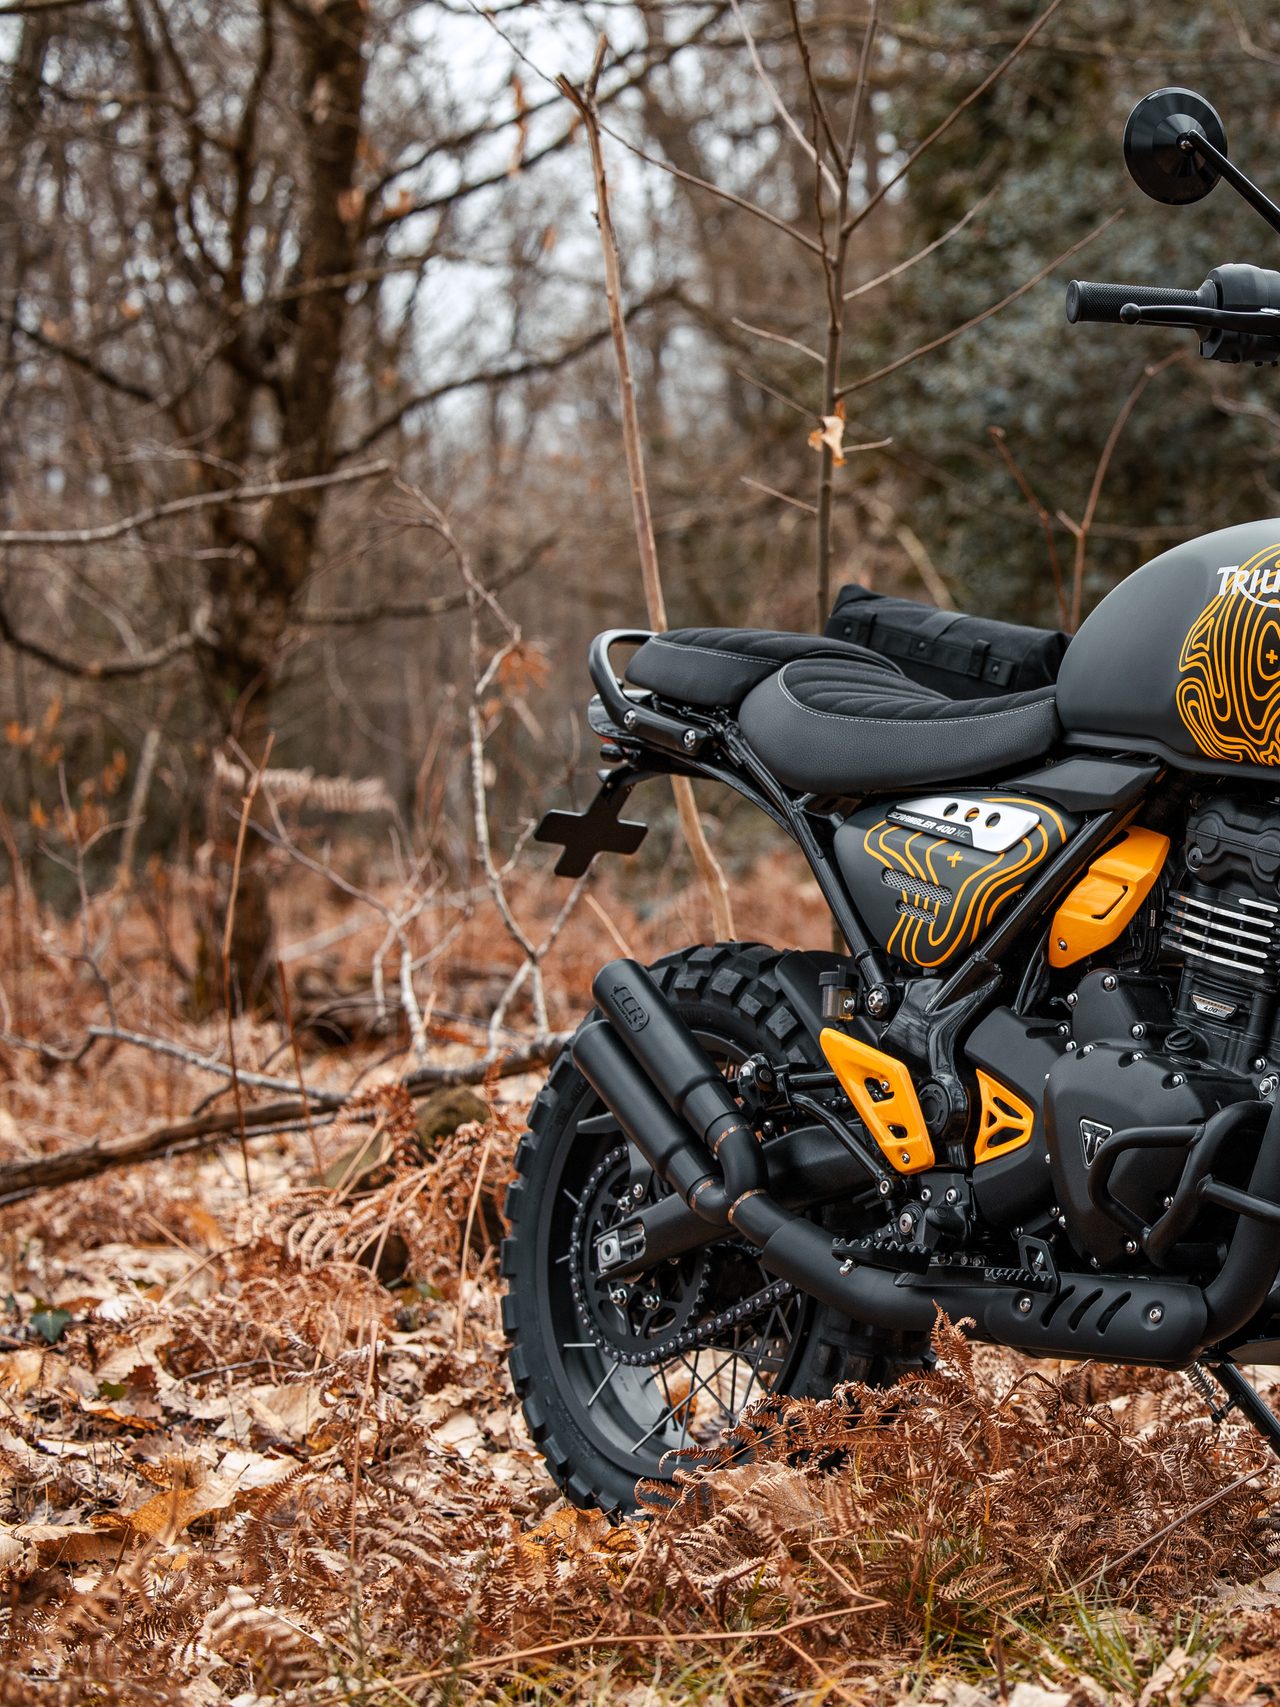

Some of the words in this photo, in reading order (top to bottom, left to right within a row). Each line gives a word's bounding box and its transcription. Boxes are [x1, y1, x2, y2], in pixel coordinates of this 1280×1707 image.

[887, 811, 937, 830] SCRAMBLER
[935, 824, 957, 835] 400
[953, 829, 970, 839] XC
